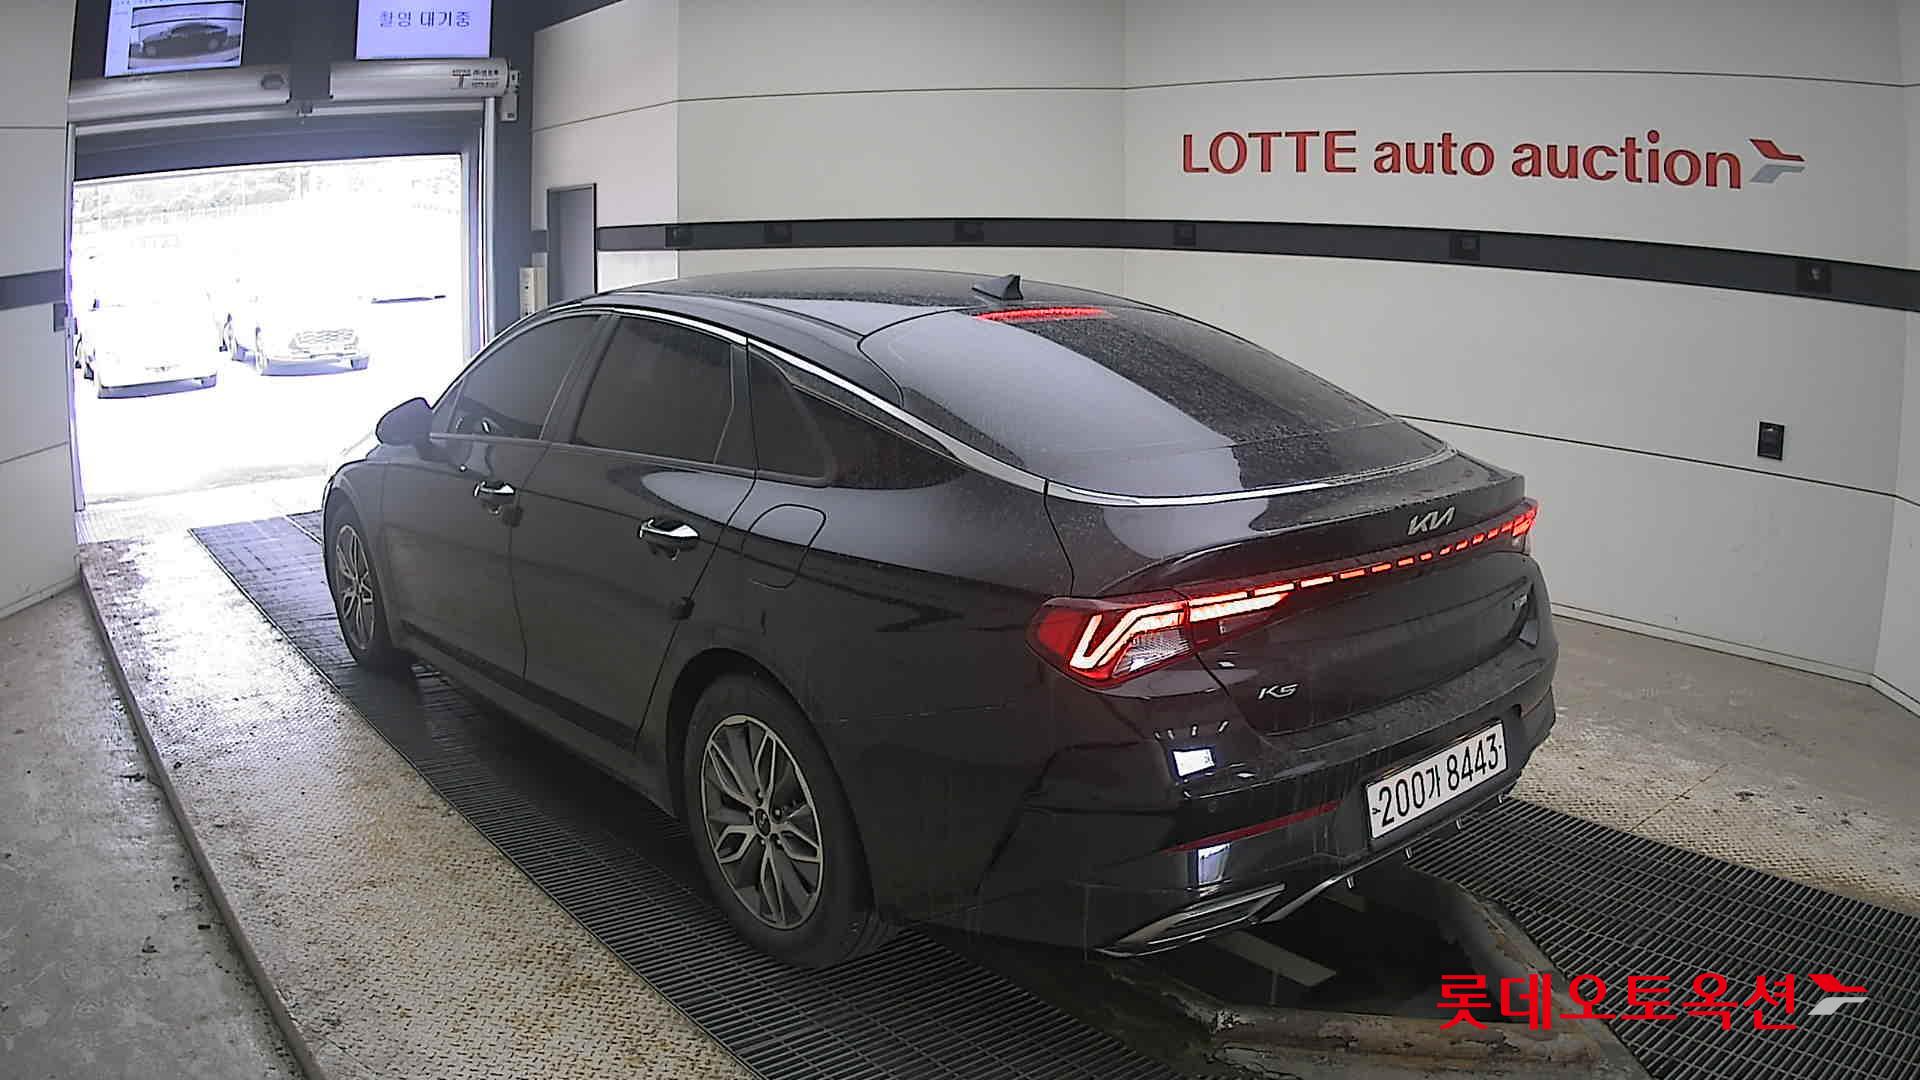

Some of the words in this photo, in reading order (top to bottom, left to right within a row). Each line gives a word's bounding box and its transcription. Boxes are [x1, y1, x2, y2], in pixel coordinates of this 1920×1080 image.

[420, 11, 470, 28] 대기중
[1182, 130, 1357, 174] LOTTE
[1374, 132, 1495, 176] auto
[1511, 130, 1742, 189] auction
[1258, 684, 1299, 700] K5
[1379, 764, 1441, 828] 200가
[1446, 733, 1499, 791] 8443
